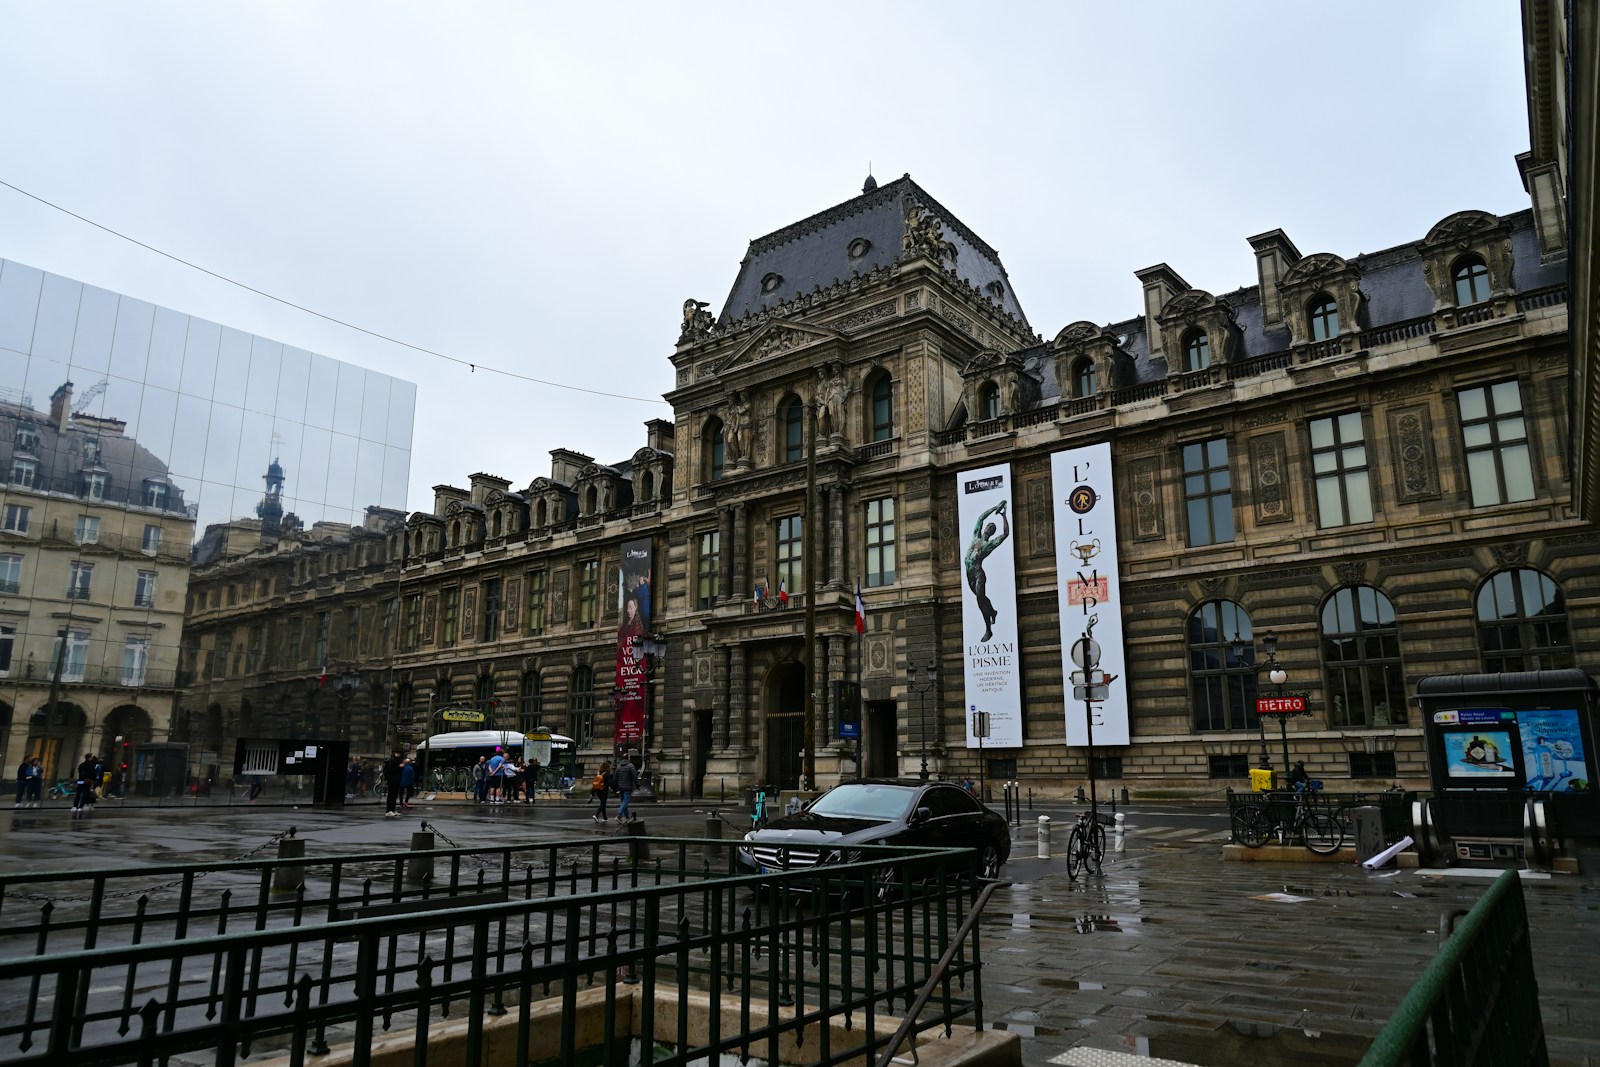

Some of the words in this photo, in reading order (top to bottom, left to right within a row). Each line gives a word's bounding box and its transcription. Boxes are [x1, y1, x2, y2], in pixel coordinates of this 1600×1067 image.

[969, 643, 1013, 656] L'OLYM
[972, 656, 1011, 668] PISME
[1259, 699, 1302, 711] METRO
